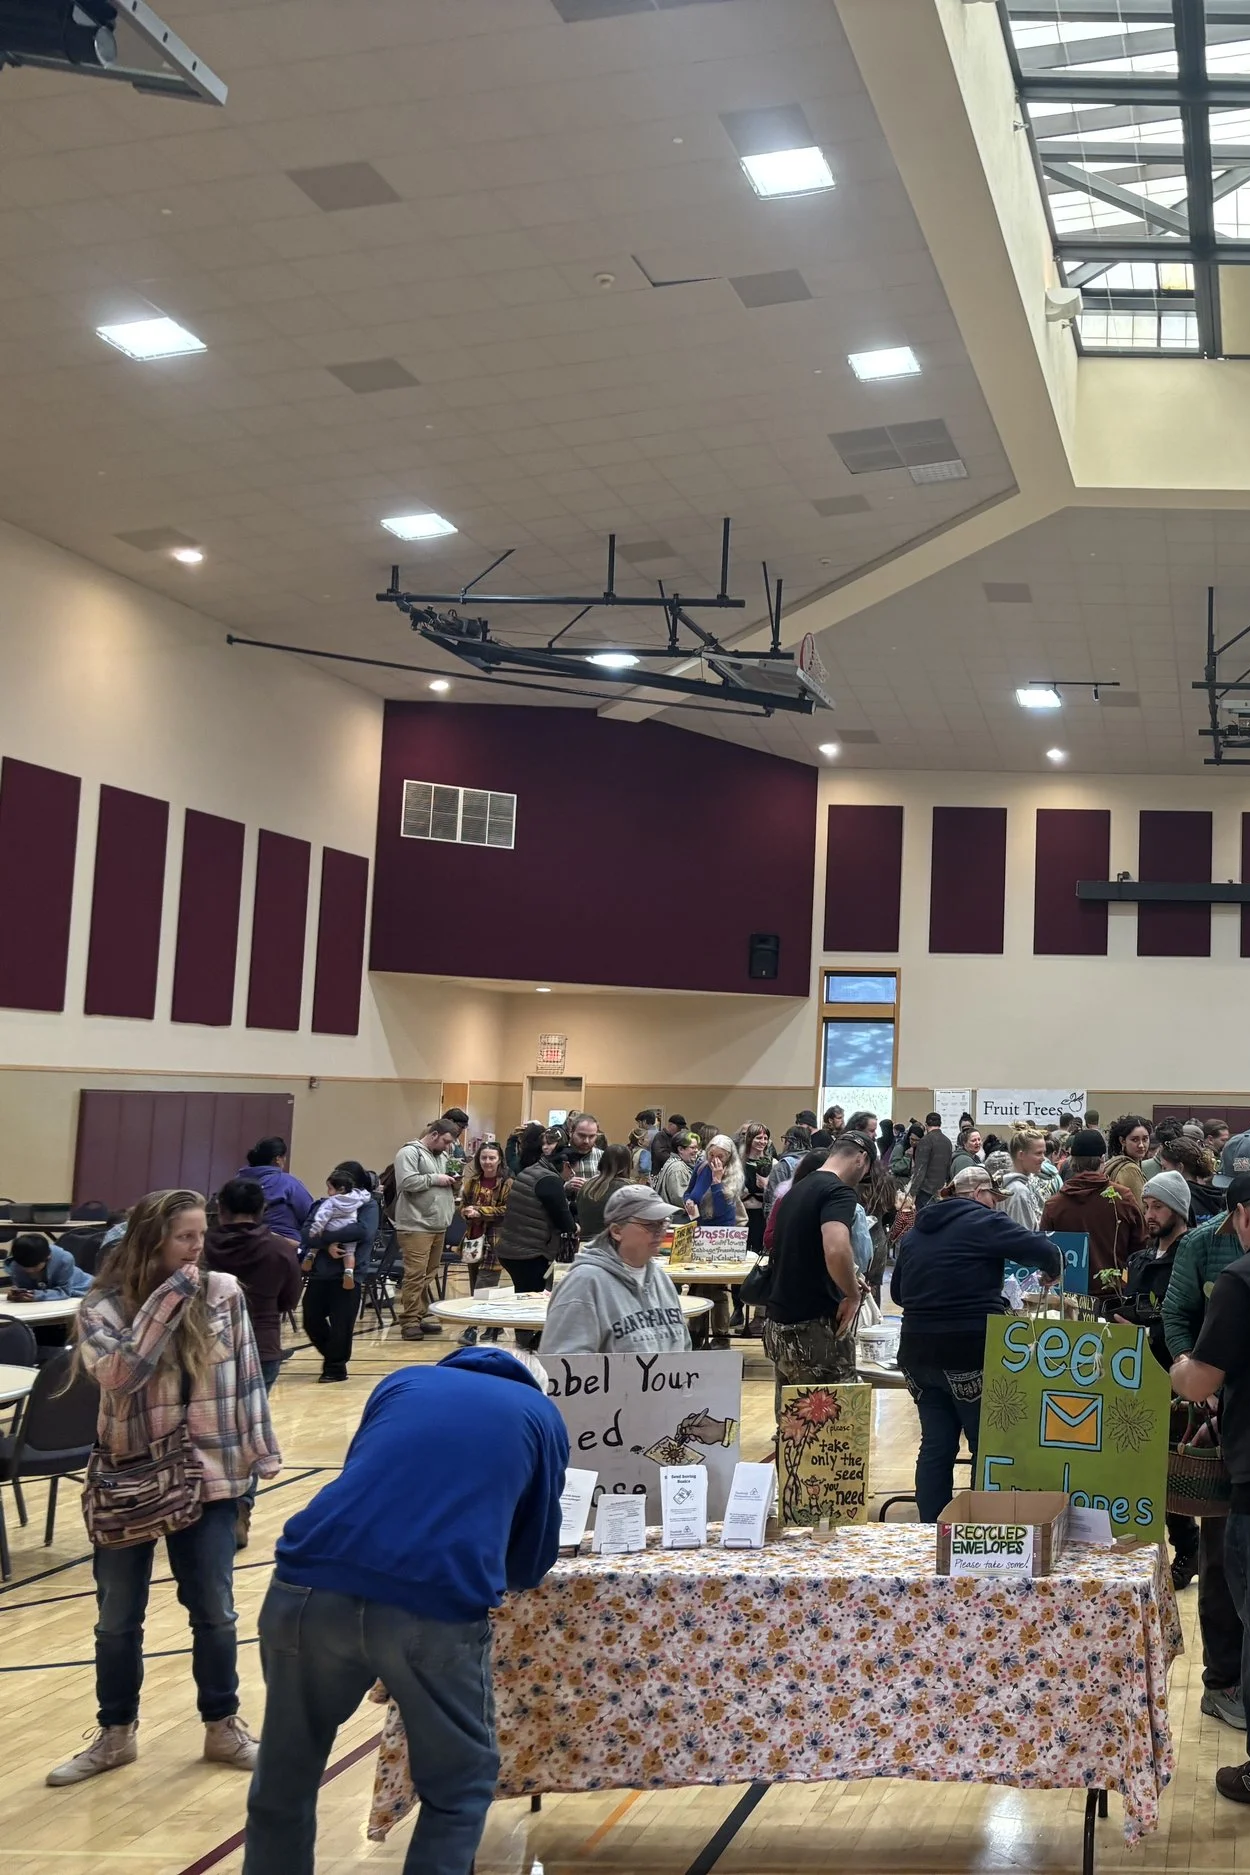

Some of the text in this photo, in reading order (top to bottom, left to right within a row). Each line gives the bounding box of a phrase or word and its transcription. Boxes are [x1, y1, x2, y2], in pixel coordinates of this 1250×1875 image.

[983, 1101, 1063, 1116] Fruit Trees
[692, 1226, 748, 1239] Brassicas
[1079, 1296, 1096, 1311] ONLY
[1082, 1312, 1095, 1322] YOU
[612, 1314, 639, 1339] SAN
[547, 1354, 699, 1396] abel Your
[577, 1408, 623, 1450] ed
[819, 1439, 849, 1453] take
[811, 1453, 862, 1471] only the
[834, 1462, 865, 1481] seed
[823, 1482, 865, 1506] you need
[983, 1455, 1153, 1526] Eloes
[953, 1524, 1027, 1540] RECYCLED
[952, 1540, 1024, 1555] ENVELOPES
[954, 1553, 1031, 1569] Please take some!
